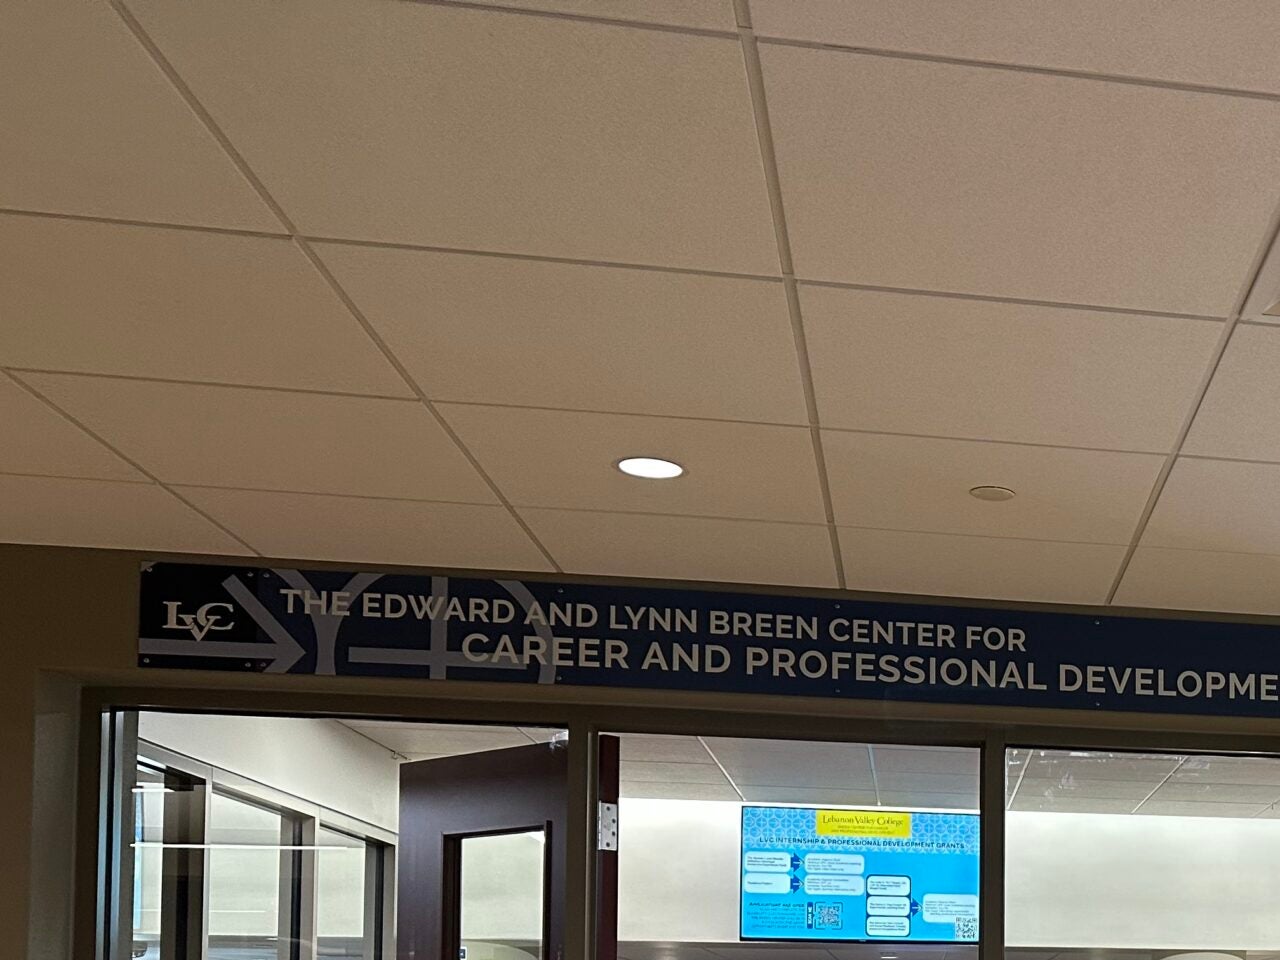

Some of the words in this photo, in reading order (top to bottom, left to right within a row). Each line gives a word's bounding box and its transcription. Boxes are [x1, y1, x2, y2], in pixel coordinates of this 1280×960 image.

[280, 588, 351, 617] THE
[362, 592, 516, 625] EDWARD
[523, 600, 599, 628] AND
[608, 604, 698, 633] LYNN
[709, 610, 818, 641] BREEN
[828, 618, 956, 648] CENTER
[966, 625, 1027, 652] FOR
[461, 632, 630, 669] CAREER
[642, 642, 732, 674] AND
[746, 646, 1047, 691] PROFESSIONAL
[828, 839, 881, 847] PROFESSIONAL
